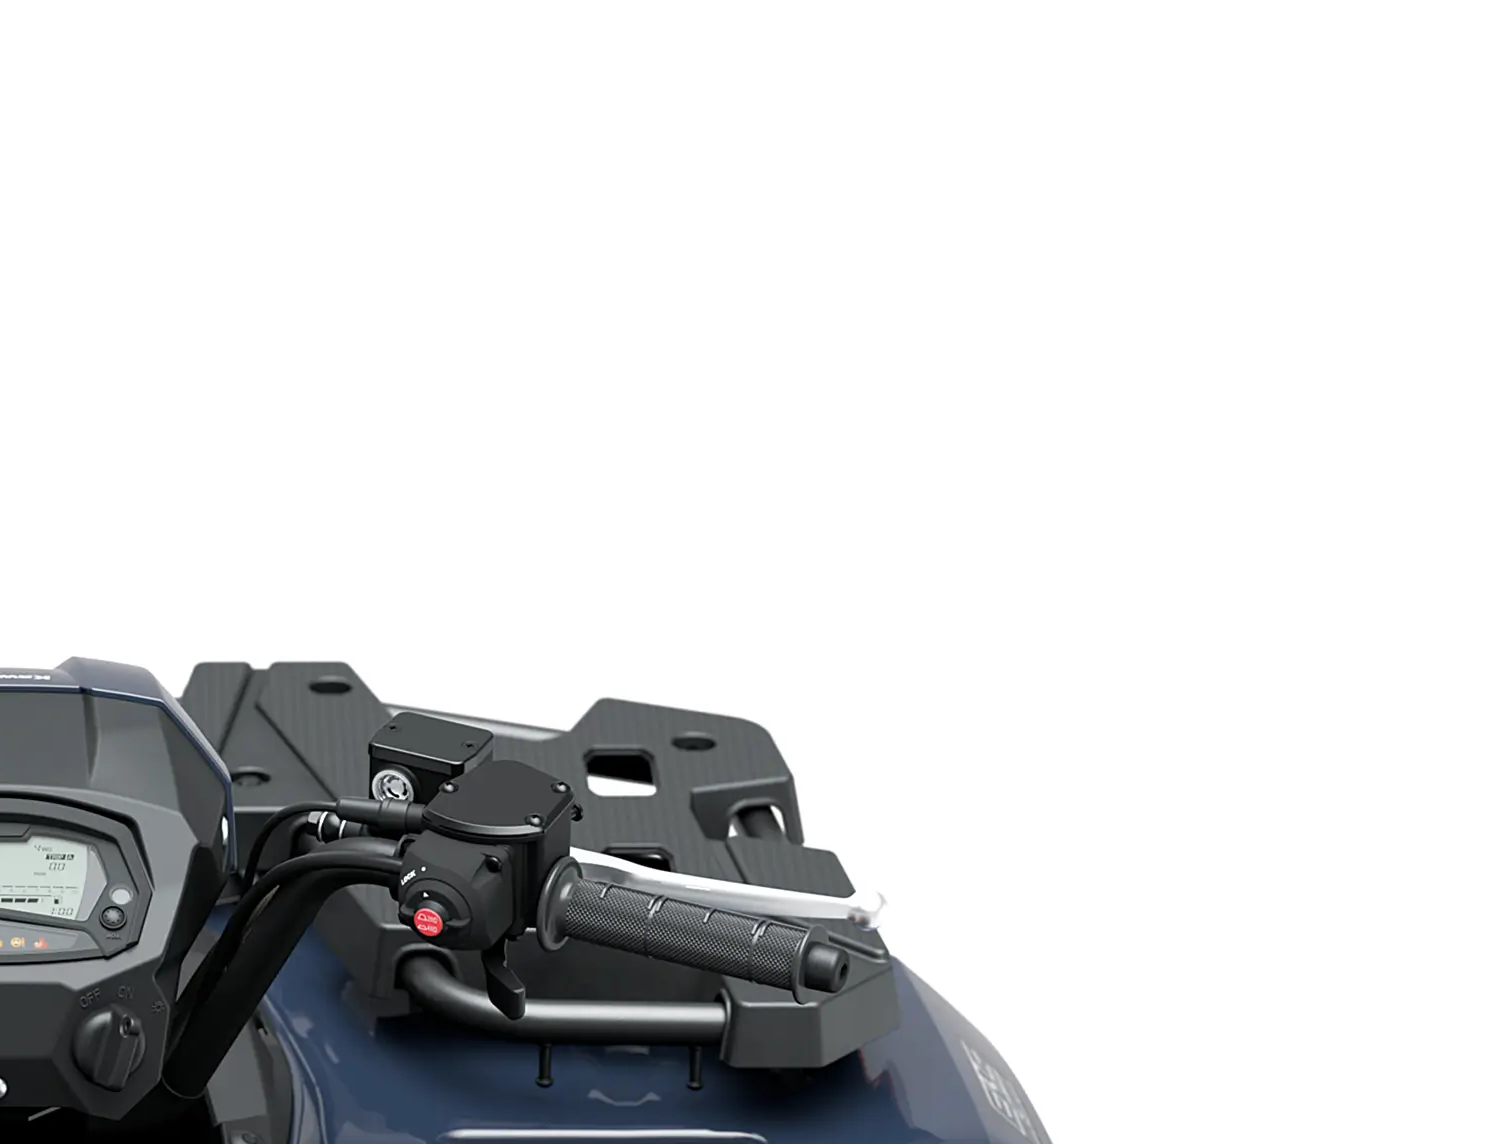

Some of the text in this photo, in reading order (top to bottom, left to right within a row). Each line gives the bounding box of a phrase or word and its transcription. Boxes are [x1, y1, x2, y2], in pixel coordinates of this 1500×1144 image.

[401, 869, 416, 886] LOCK
[79, 987, 101, 1008] OFF
[117, 985, 135, 999] ON
